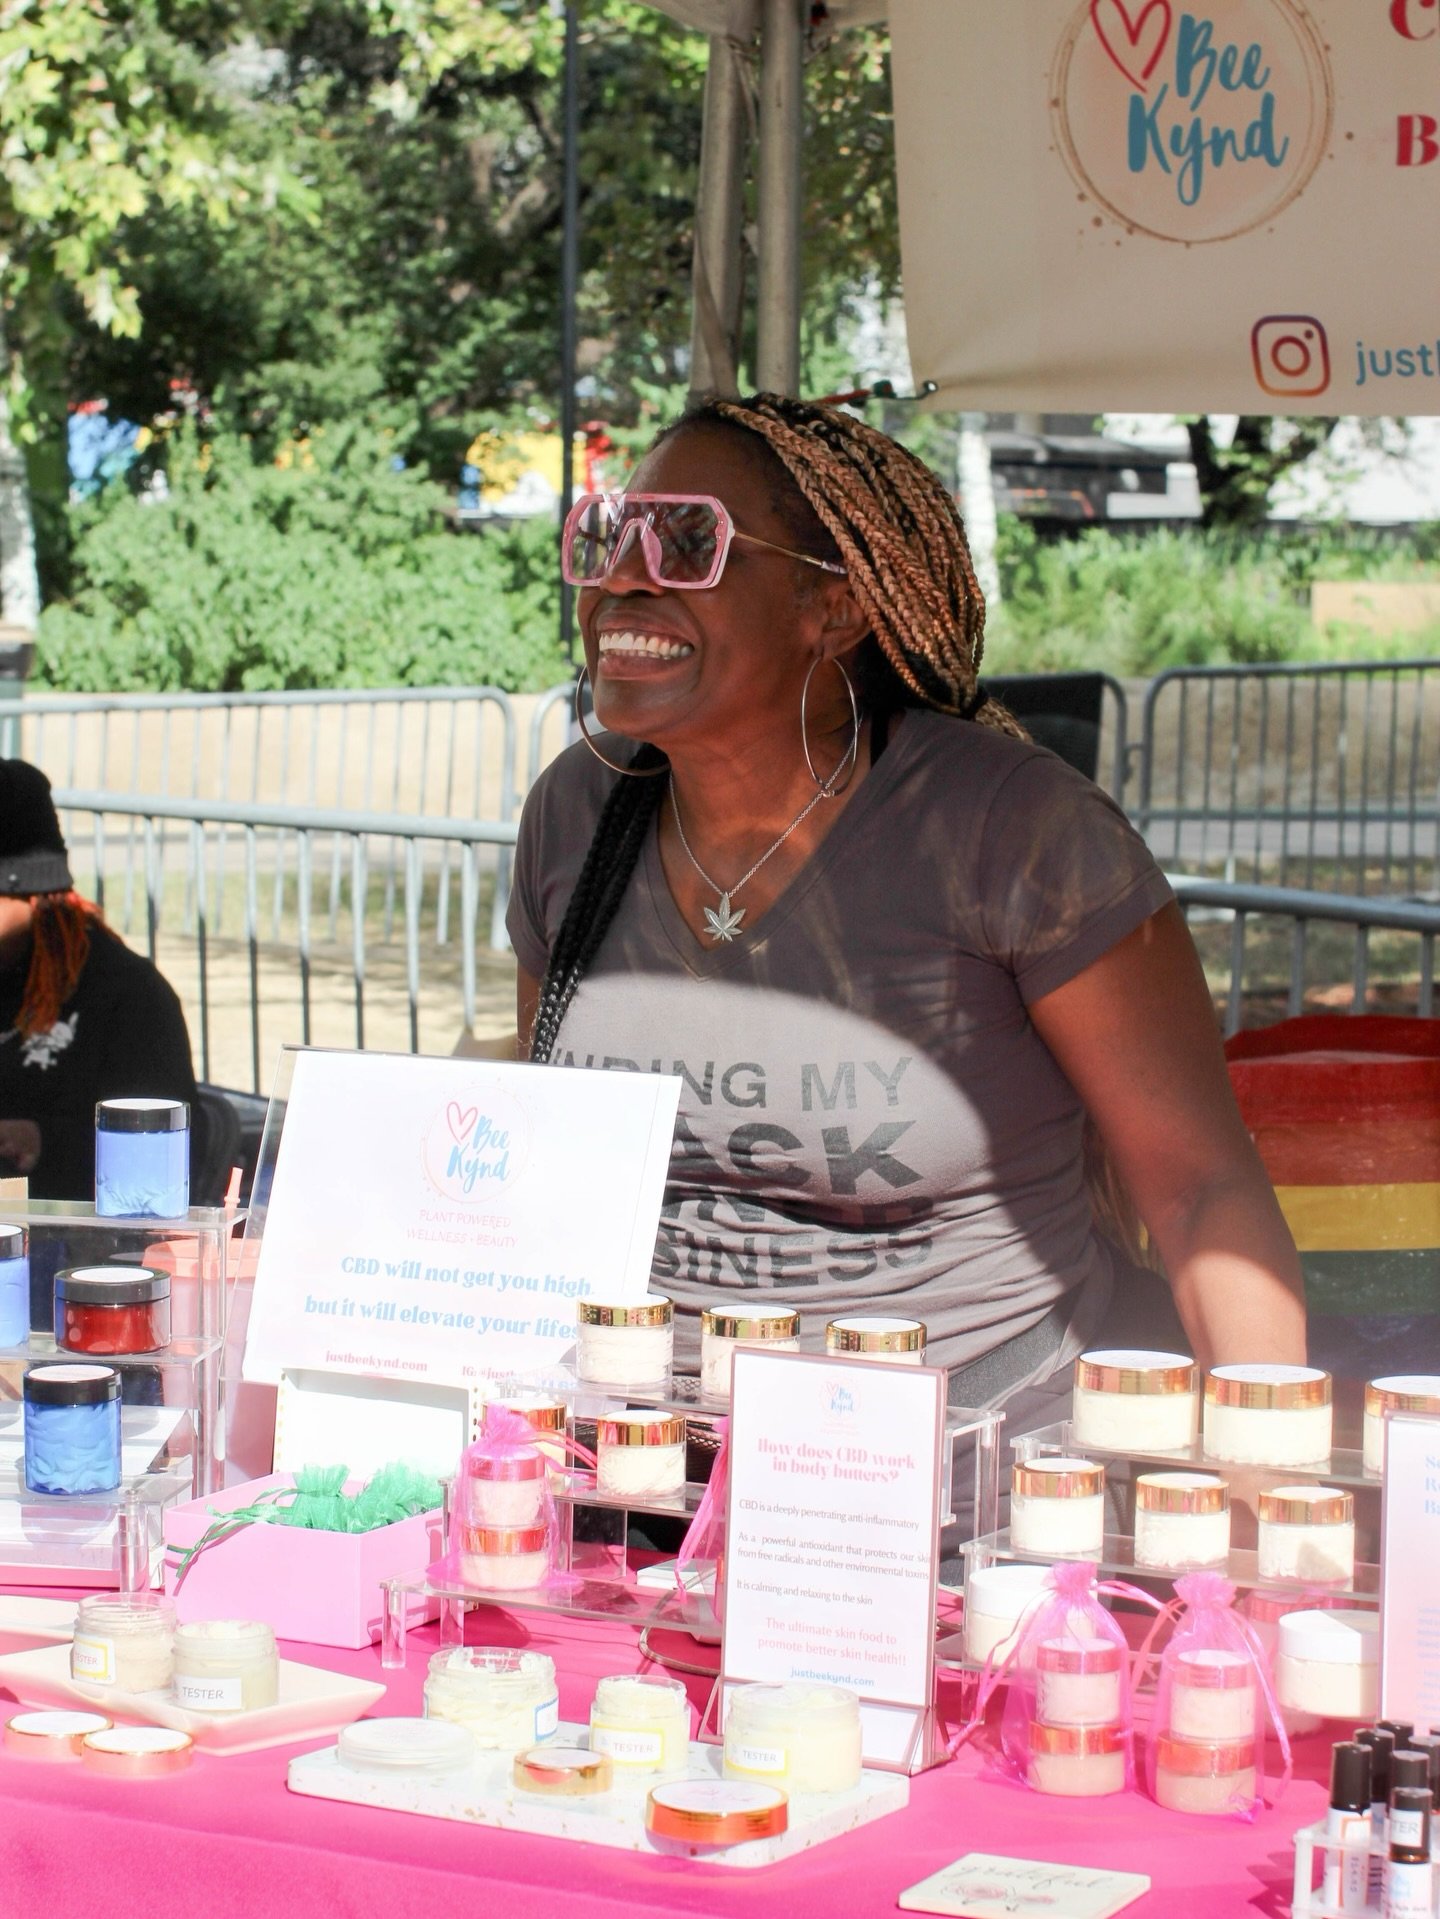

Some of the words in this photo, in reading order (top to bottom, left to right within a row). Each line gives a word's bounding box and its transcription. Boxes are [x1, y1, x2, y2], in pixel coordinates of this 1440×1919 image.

[1175, 14, 1270, 110] Bee
[1128, 83, 1290, 206] Kynd
[1356, 340, 1440, 386] just
[801, 1057, 913, 1111] MY
[472, 1115, 511, 1155] Bee
[447, 1142, 512, 1194] Kynd
[419, 1208, 457, 1222] PLANT
[458, 1212, 512, 1229] POWERED
[406, 1228, 468, 1244] WELLNESS
[475, 1233, 518, 1248] BEAUTY
[340, 1255, 380, 1276] CBD
[385, 1259, 421, 1280] will
[424, 1266, 459, 1284] not
[463, 1270, 495, 1289] get
[499, 1275, 539, 1294] you
[304, 1294, 338, 1315] but
[341, 1297, 355, 1317] it
[360, 1301, 396, 1321] will
[399, 1305, 475, 1330] elevate
[478, 1316, 532, 1337] your
[325, 1350, 428, 1372] justbeekynd.com
[757, 1438, 793, 1455] How
[796, 1443, 833, 1459] does
[837, 1447, 868, 1464] CBD
[872, 1453, 916, 1470] work
[772, 1456, 787, 1472] in
[790, 1459, 827, 1480] body
[833, 1463, 900, 1483] butters?
[738, 1499, 758, 1511] CBD
[759, 1501, 765, 1511] is
[773, 1503, 800, 1518] deeply
[800, 1507, 847, 1523] penetrating
[847, 1512, 920, 1531] anti-inflammatory
[737, 1547, 756, 1559] from
[757, 1548, 773, 1560] free
[774, 1551, 805, 1565] radicals
[805, 1556, 821, 1567] and
[822, 1557, 844, 1569] other
[845, 1562, 903, 1577] environmental
[738, 1531, 748, 1542] As
[761, 1533, 797, 1549] powerful
[798, 1540, 843, 1554] antioxidant
[846, 1543, 862, 1556] that
[864, 1548, 898, 1563] protects
[899, 1552, 914, 1562] our
[736, 1579, 743, 1589] It
[743, 1580, 750, 1589] is
[750, 1581, 782, 1596] calming
[783, 1585, 799, 1596] and
[800, 1588, 831, 1603] relaxing
[832, 1591, 840, 1601] to
[842, 1592, 855, 1602] the
[856, 1594, 873, 1606] skin
[765, 1616, 785, 1631] The
[788, 1620, 832, 1637] ultimate
[835, 1626, 856, 1640] skin
[858, 1629, 883, 1644] food
[885, 1633, 897, 1645] to
[757, 1636, 802, 1653] promote
[806, 1641, 837, 1657] better
[840, 1646, 861, 1660] skin
[864, 1649, 907, 1667] health!!
[790, 1666, 876, 1687] justbeekynd.com
[182, 1686, 225, 1700] TESTER
[613, 1742, 656, 1754] TESTER
[742, 1750, 777, 1763] TESTER
